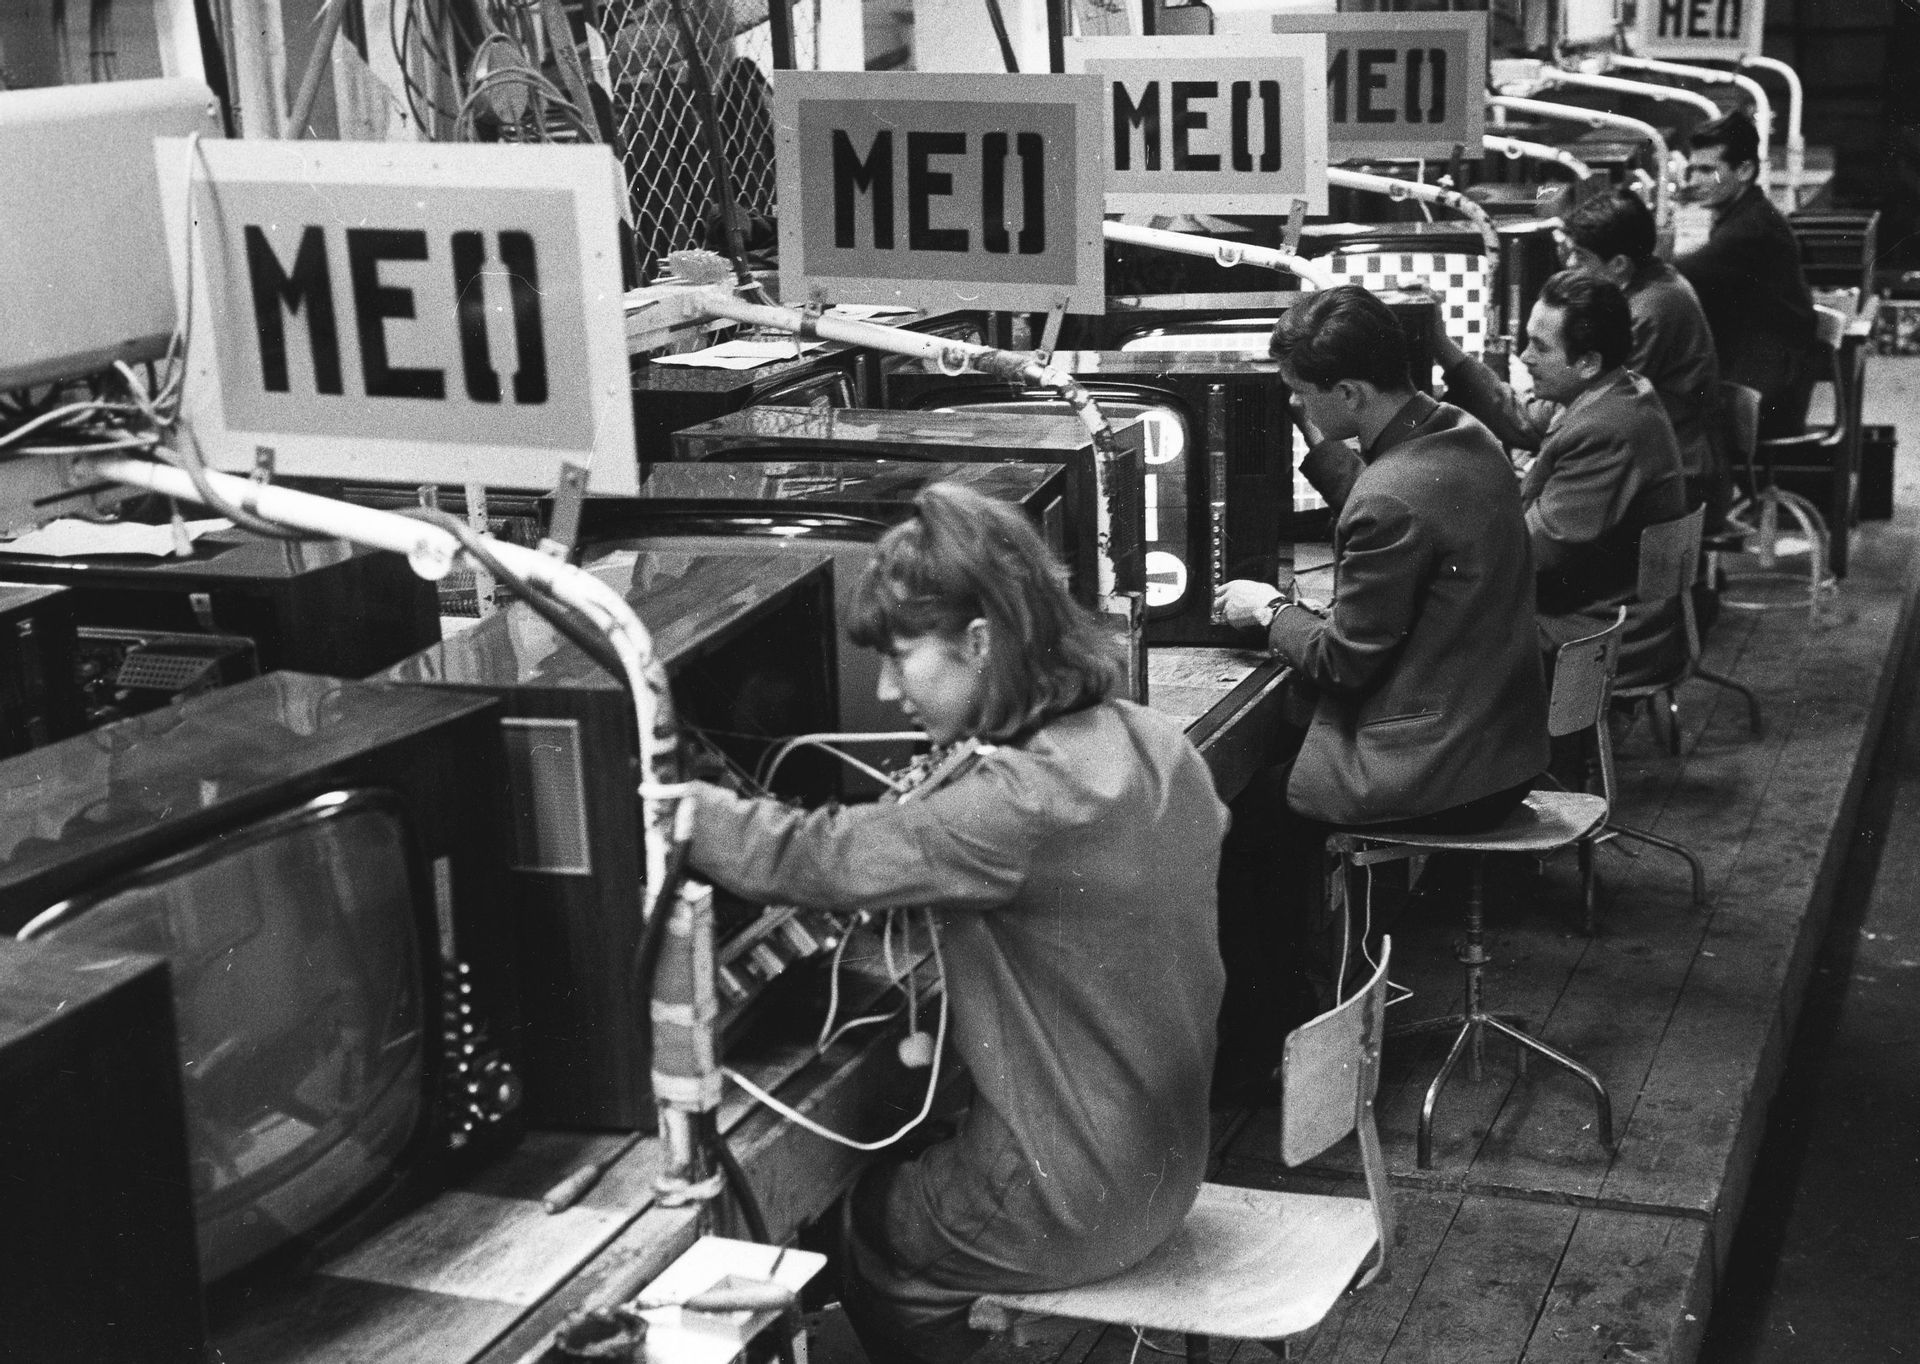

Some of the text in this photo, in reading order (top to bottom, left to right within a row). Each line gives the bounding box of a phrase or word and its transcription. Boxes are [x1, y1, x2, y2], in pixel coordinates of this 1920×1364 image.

[1113, 80, 1282, 172] MEO
[832, 129, 1045, 254] MEO
[244, 225, 549, 405] MEO
